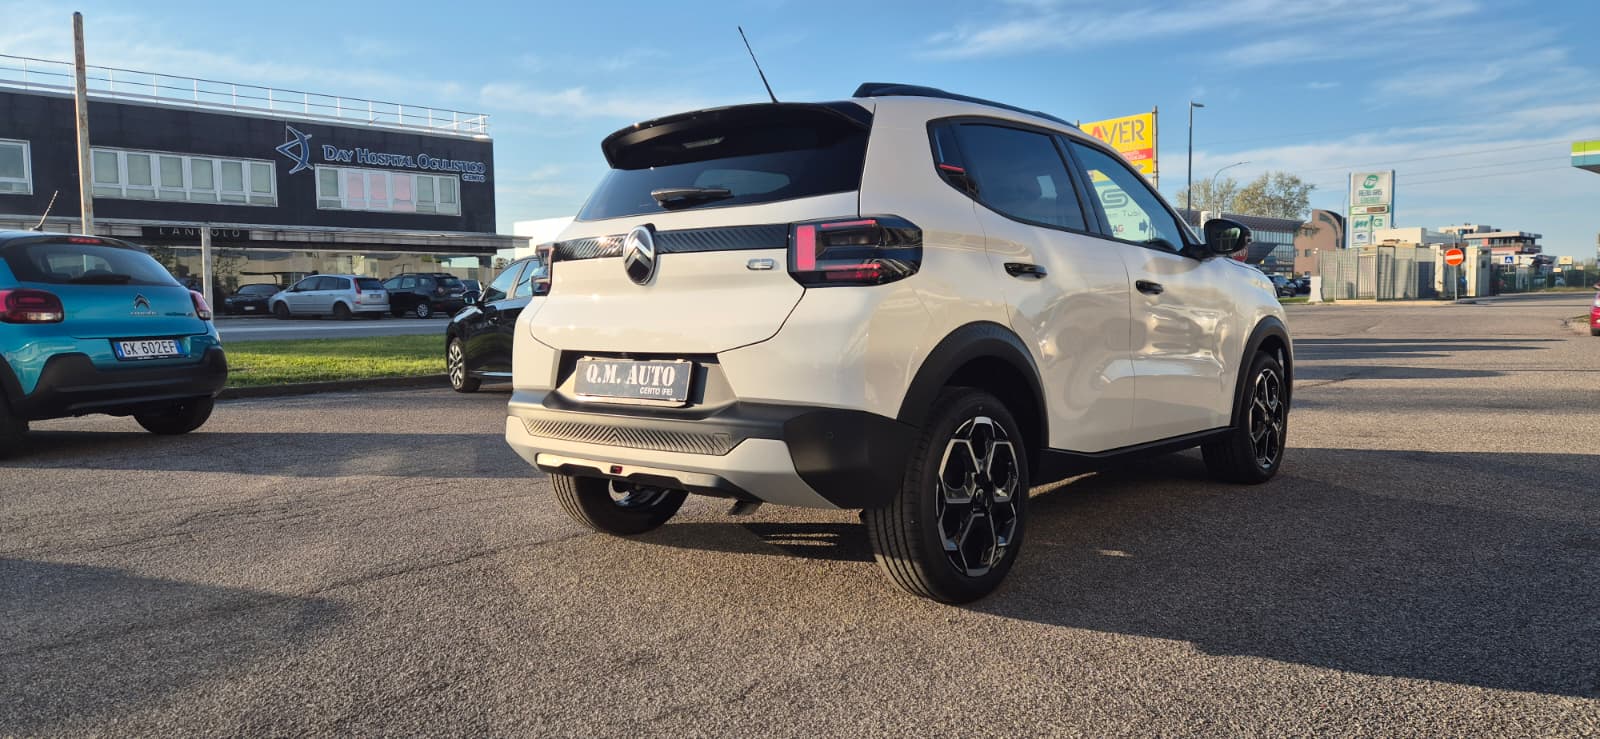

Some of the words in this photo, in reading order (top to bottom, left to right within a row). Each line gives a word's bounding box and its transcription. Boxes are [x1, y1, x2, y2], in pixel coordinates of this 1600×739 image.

[586, 364, 621, 384] Q.M.
[626, 364, 676, 387] AUTO
[640, 386, 660, 396] CENTO
[661, 387, 673, 396] (FE)
